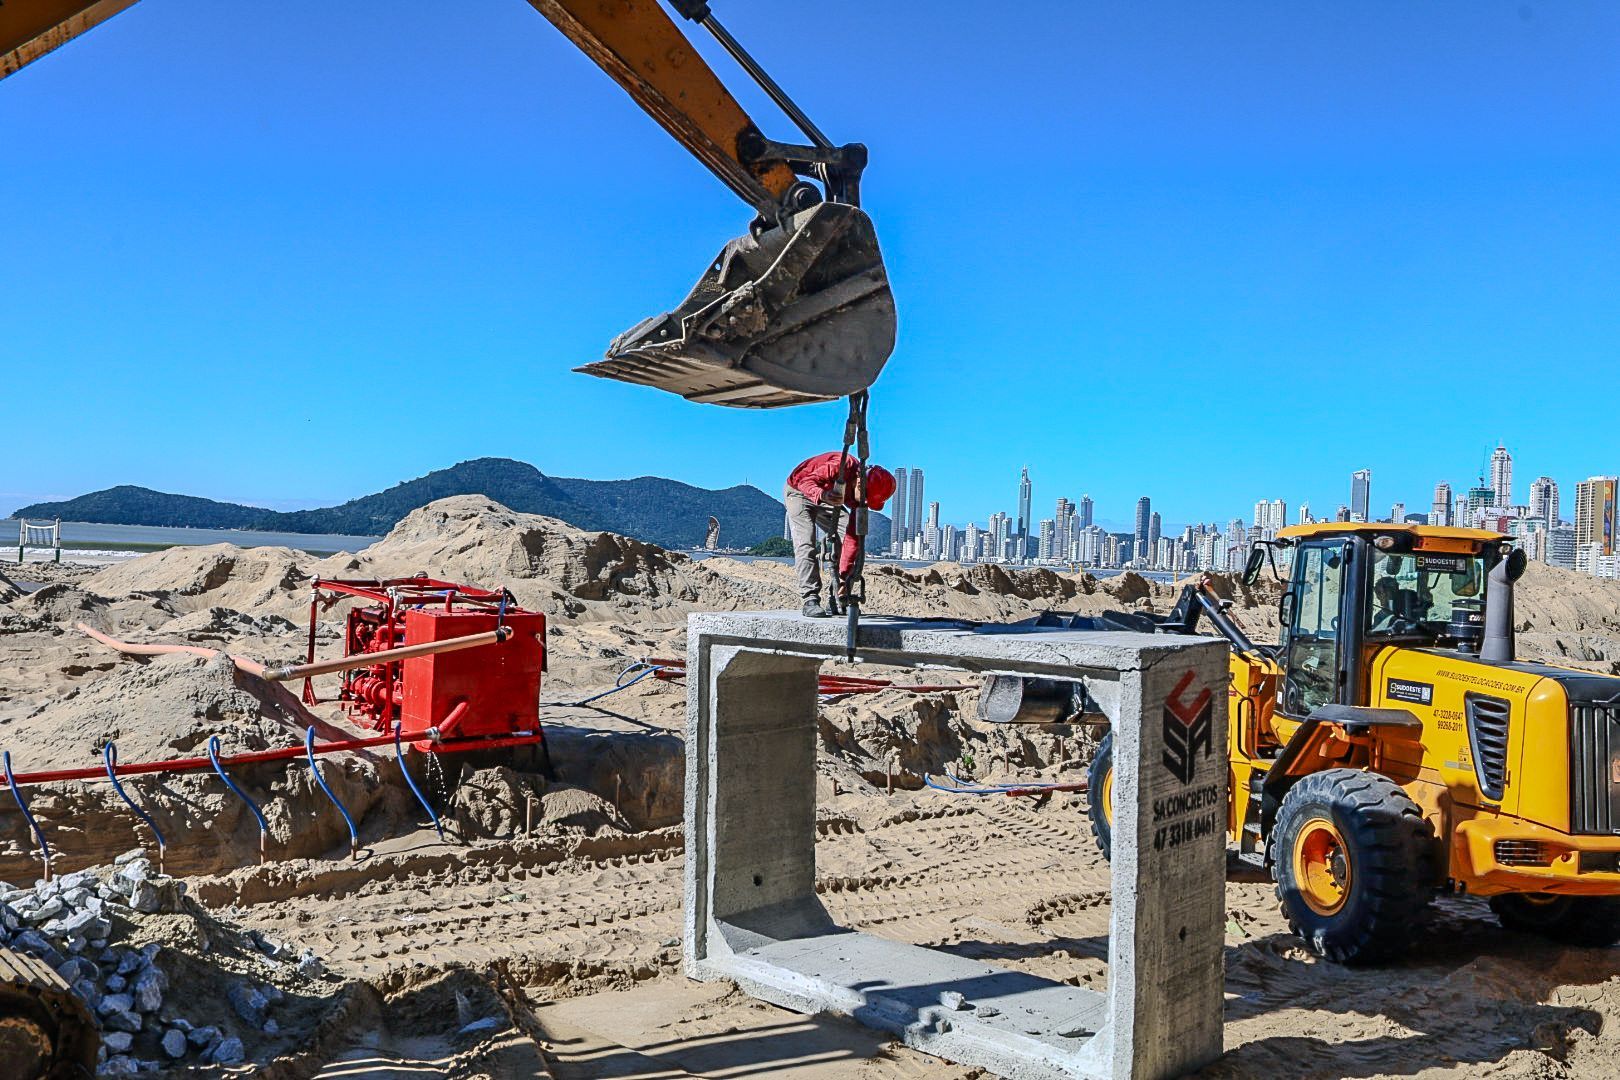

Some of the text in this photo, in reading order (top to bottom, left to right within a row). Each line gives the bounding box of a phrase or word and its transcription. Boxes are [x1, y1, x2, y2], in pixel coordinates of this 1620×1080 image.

[1397, 684, 1422, 694] SUDOESTE
[1153, 784, 1218, 822] SA CONCRETOS
[1154, 812, 1216, 852] 47 3318 0461
